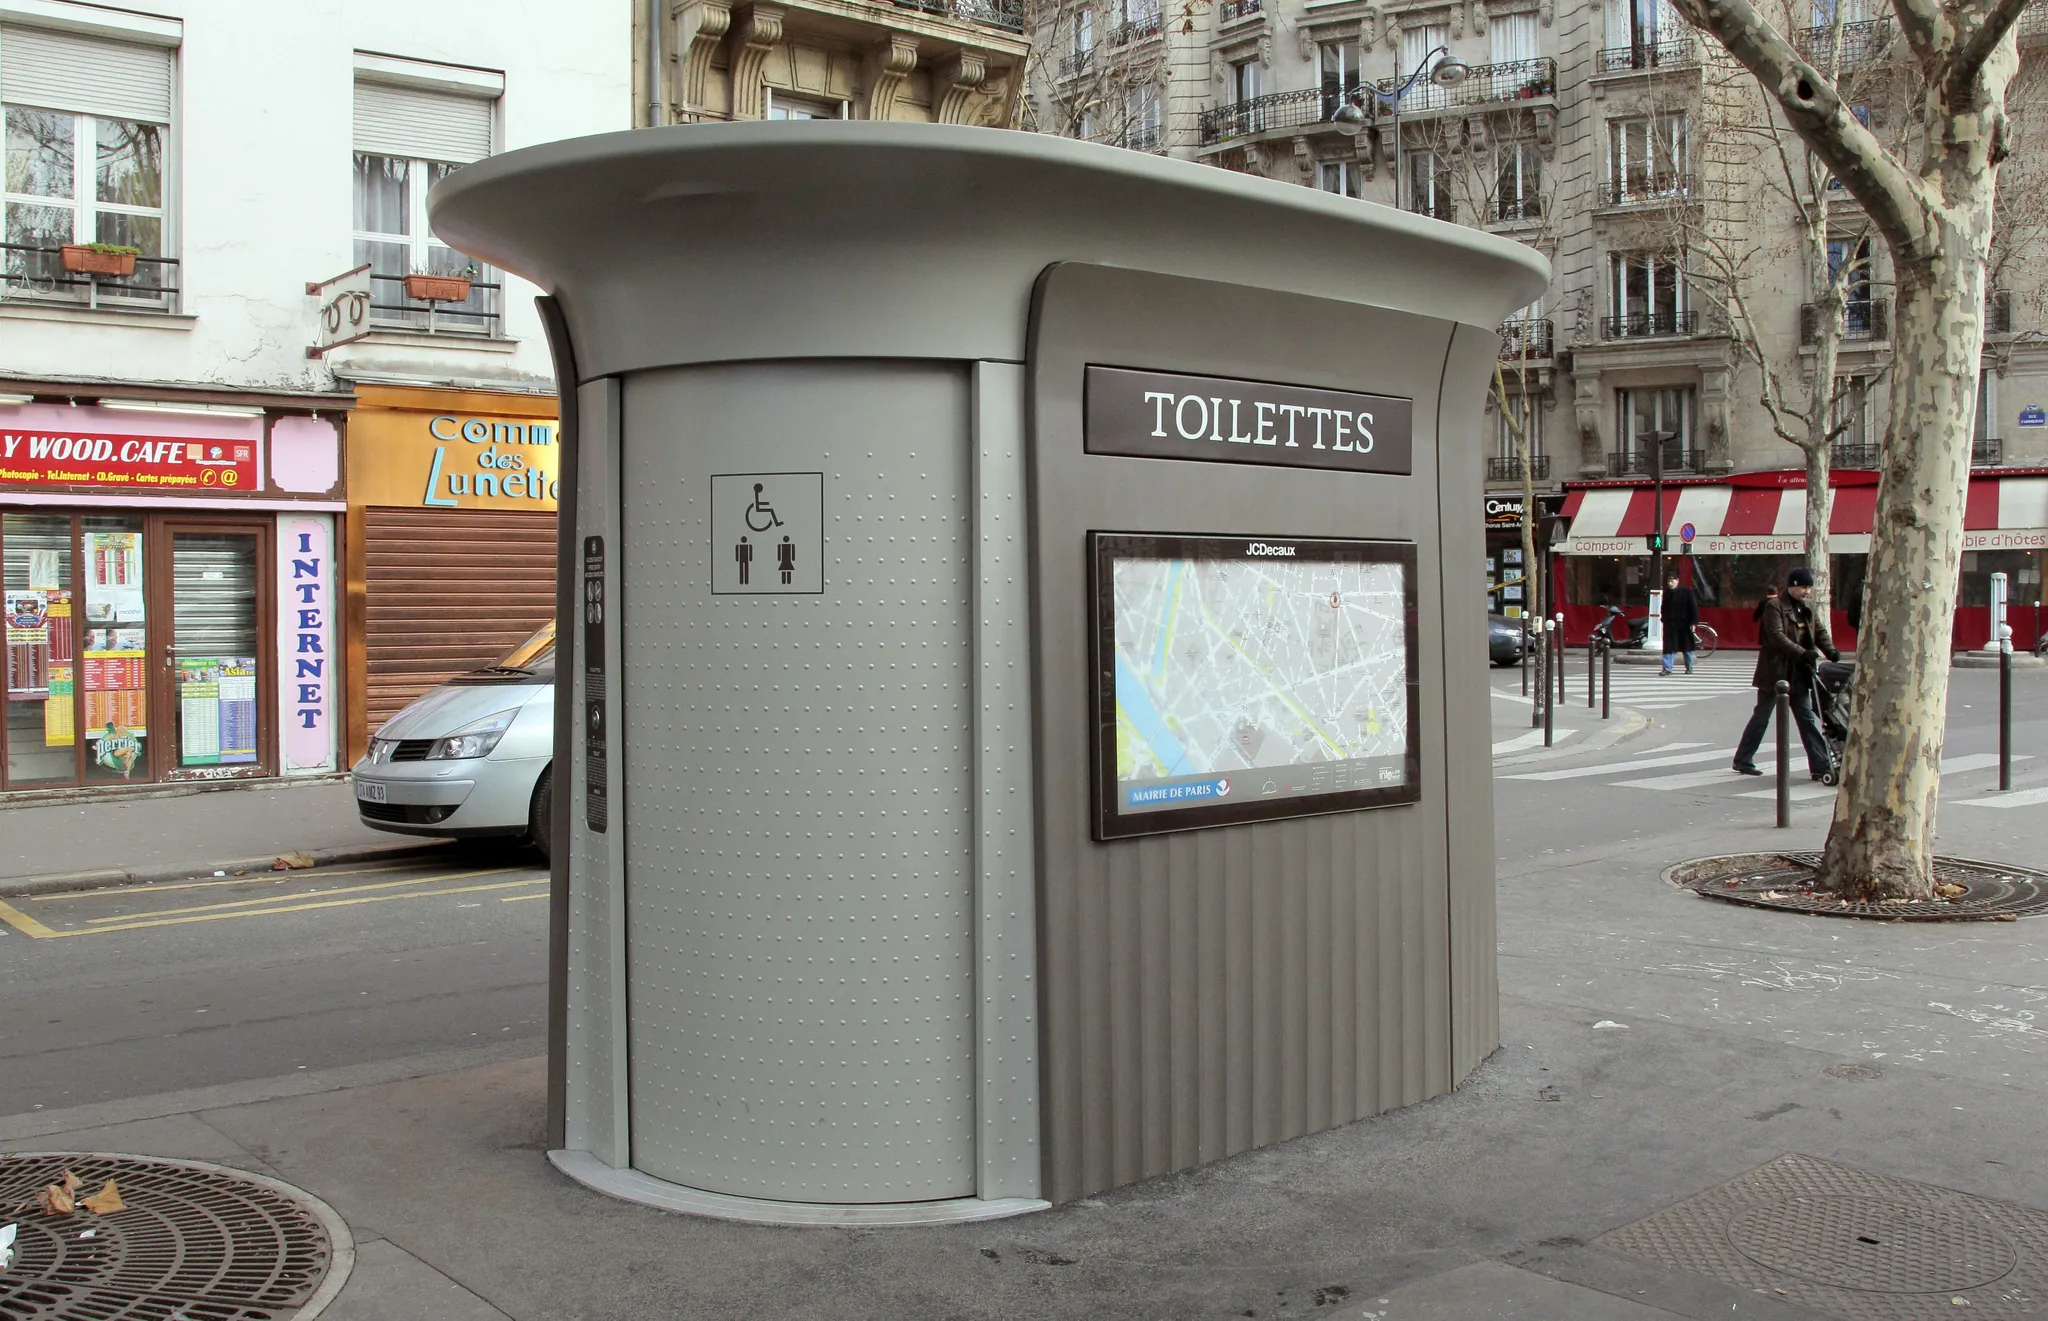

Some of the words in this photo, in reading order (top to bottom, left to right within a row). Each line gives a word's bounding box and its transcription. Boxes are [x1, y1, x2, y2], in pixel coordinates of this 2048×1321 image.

[1144, 391, 1374, 454] TOILETTES
[430, 415, 559, 445] Comm
[29, 436, 186, 464] WOOD.CAFE
[235, 449, 249, 459] SFR
[136, 472, 158, 483] Cartes
[160, 473, 197, 485] prépayées
[1486, 500, 1523, 514] Century
[1246, 543, 1296, 556] JCDecaux
[1730, 539, 1799, 551] attendant
[292, 533, 324, 728] INTERNET
[225, 667, 245, 676] Asia
[1133, 789, 1167, 802] MAIRIE
[1170, 788, 1182, 798] DE
[1185, 784, 1211, 796] PARIS
